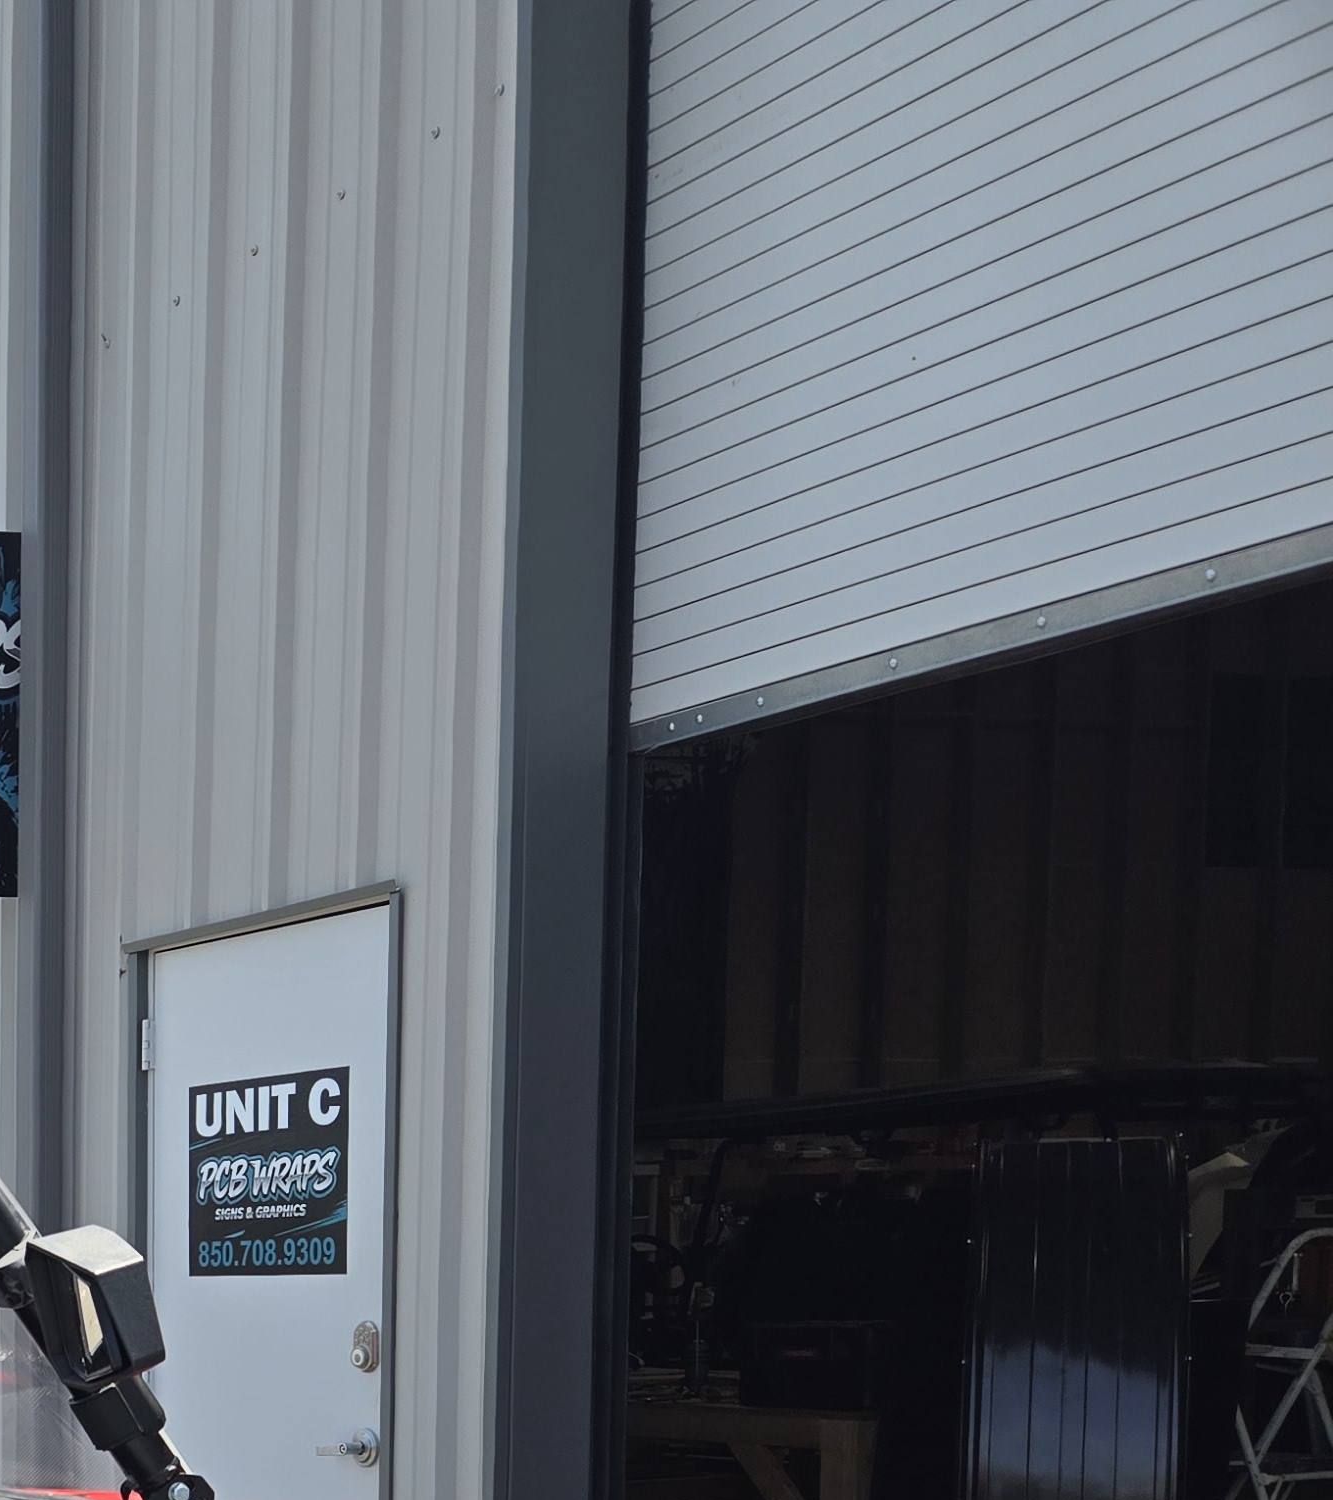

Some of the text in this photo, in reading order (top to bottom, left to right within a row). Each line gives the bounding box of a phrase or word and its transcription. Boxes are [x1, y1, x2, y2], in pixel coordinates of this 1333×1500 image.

[195, 1077, 341, 1138] UNIT C
[199, 1150, 337, 1200] PCB WRAPS
[214, 1203, 307, 1221] SIGNS & GRAPHICS
[198, 1236, 336, 1268] 850.708.9309
